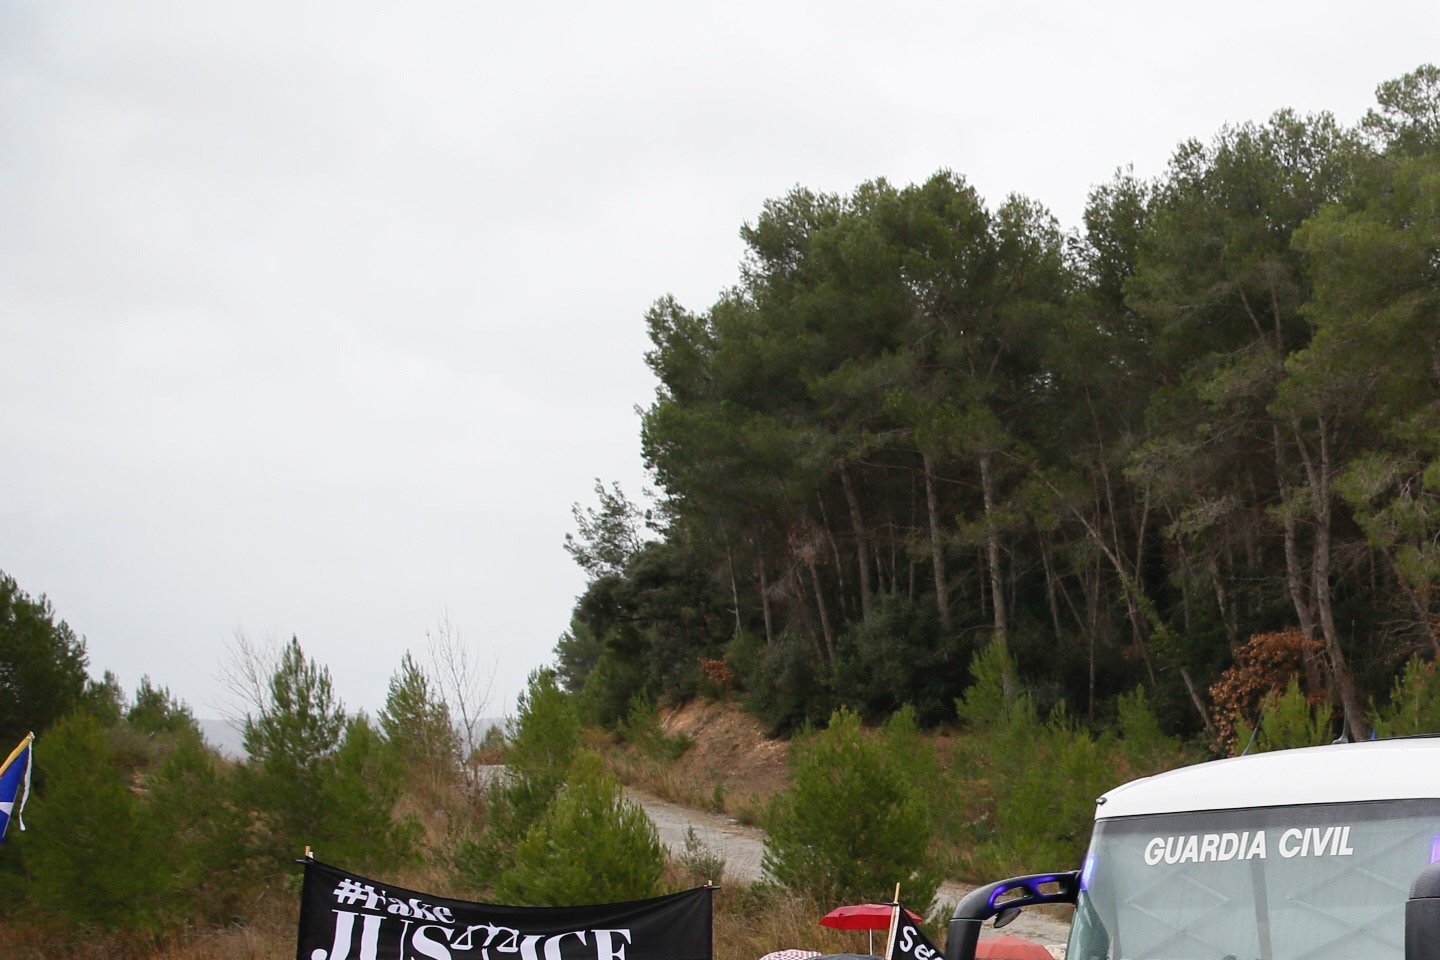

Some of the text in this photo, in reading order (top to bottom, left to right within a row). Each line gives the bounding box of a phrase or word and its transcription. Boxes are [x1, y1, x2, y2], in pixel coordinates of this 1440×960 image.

[1144, 826, 1354, 866] GUARDIA CIVIL
[333, 878, 456, 924] #Fake
